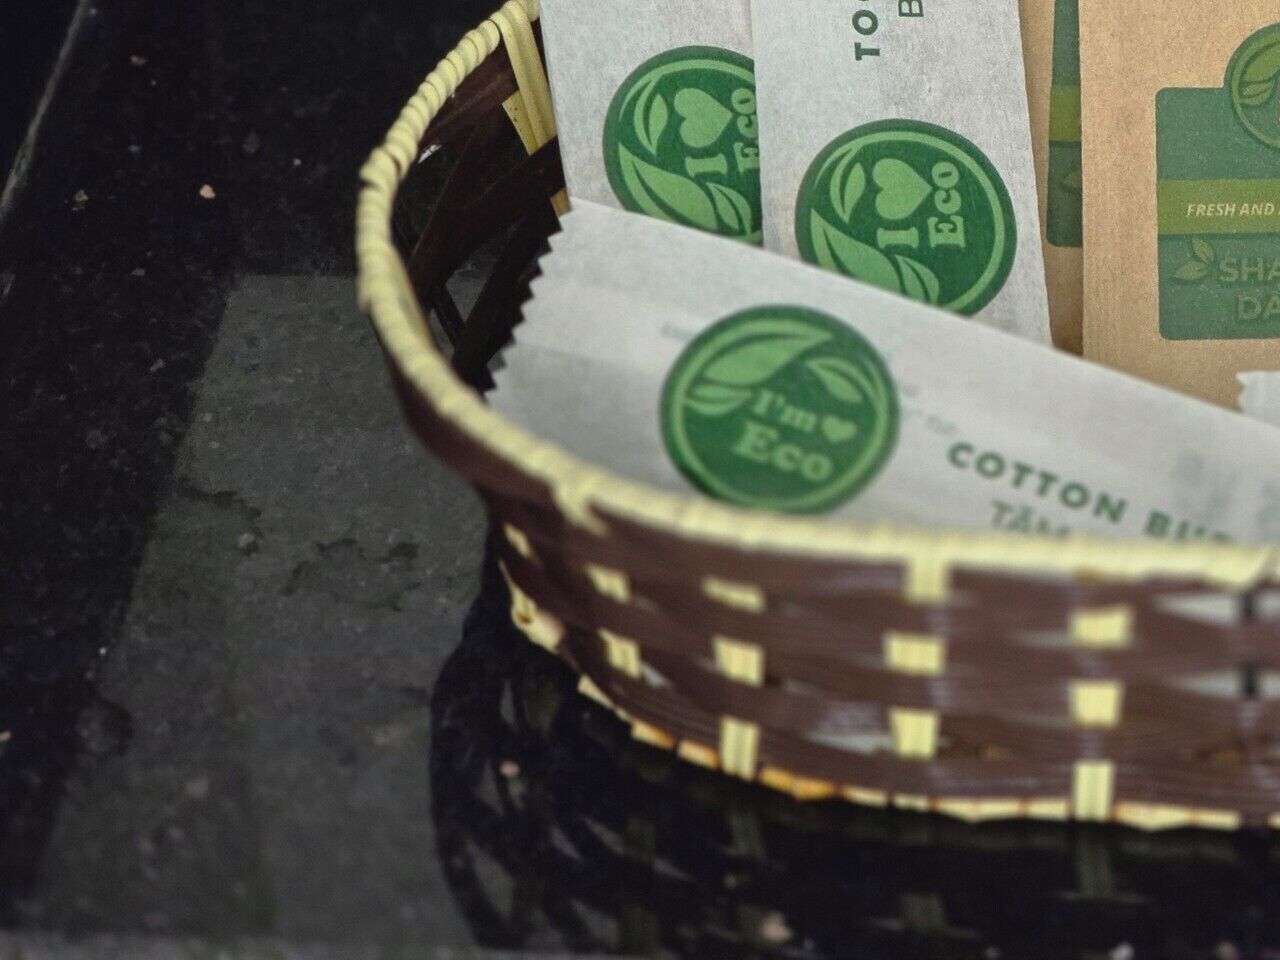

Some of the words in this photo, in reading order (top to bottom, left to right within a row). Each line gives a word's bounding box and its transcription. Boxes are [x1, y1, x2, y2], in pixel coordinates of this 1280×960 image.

[927, 161, 966, 249] Eco
[1186, 202, 1236, 217] FRESH
[1239, 202, 1275, 216] AND
[733, 420, 834, 483] Eco
[945, 440, 1129, 525] COTTON
